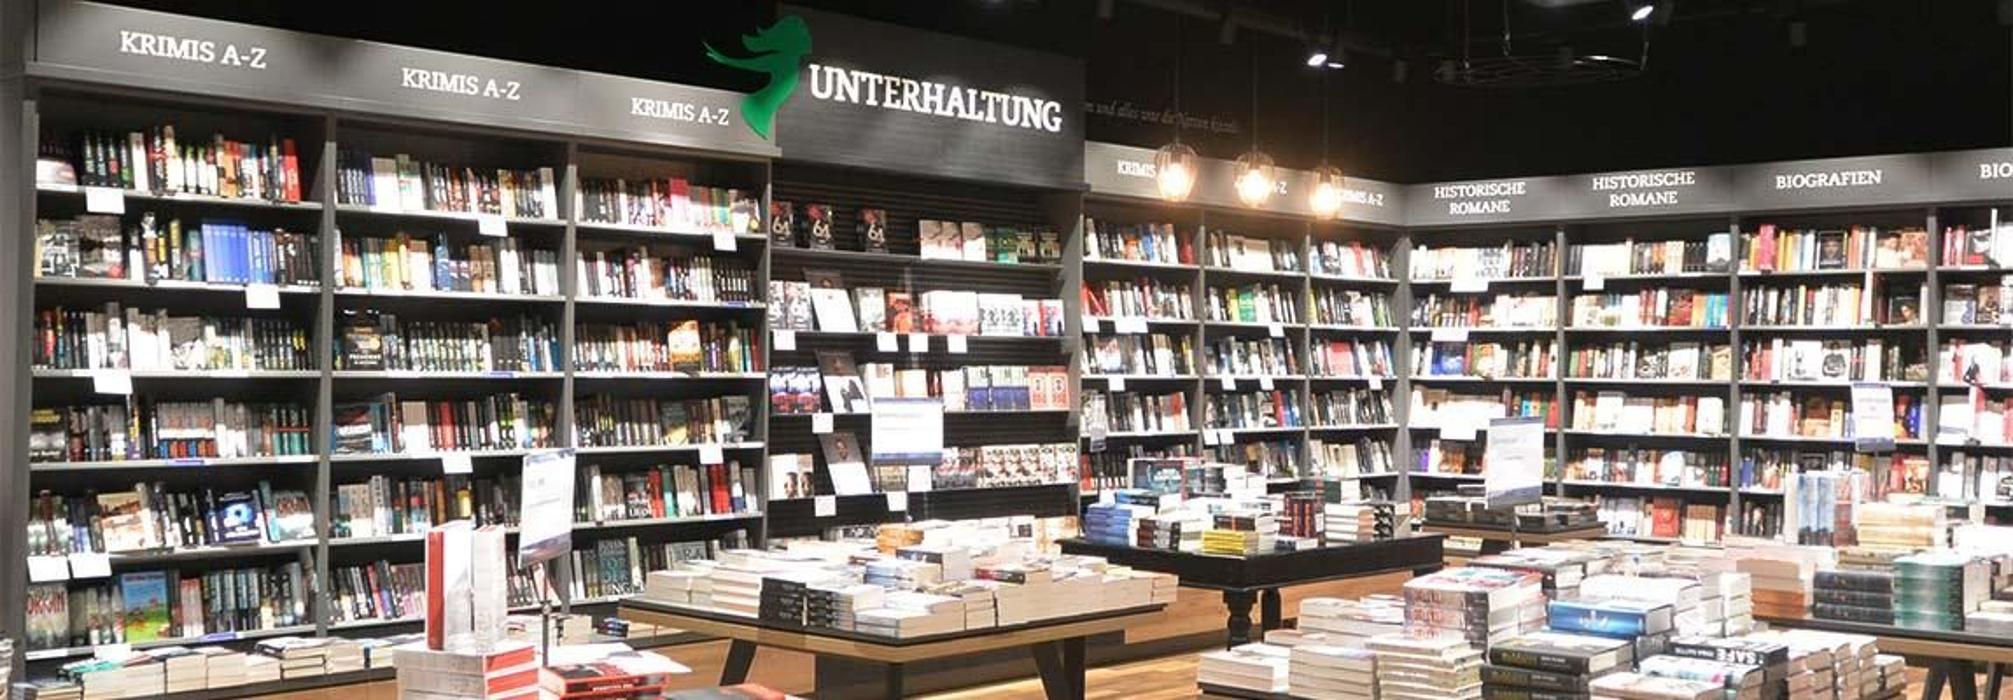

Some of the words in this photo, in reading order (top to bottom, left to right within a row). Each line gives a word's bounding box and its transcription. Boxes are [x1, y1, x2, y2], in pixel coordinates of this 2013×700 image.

[120, 31, 216, 63] KRIMIS
[220, 44, 267, 69] A-Z
[401, 67, 479, 95] KRIMIS
[483, 80, 521, 101] A-Z
[808, 64, 1063, 132] UNTERHALTUNG
[631, 98, 695, 121] KRIMIS
[698, 108, 729, 126] A-Z
[1117, 160, 1157, 178] KRIMIS
[1980, 162, 2013, 179] BIO
[1592, 172, 1696, 191] HISTORISCHE
[1776, 170, 1883, 190] BIOGRAFIEN
[1434, 182, 1527, 199] HISTORISCHE
[1609, 191, 1678, 208] ROMANE
[1449, 199, 1511, 215] ROMANE
[813, 219, 832, 239] 64
[868, 223, 885, 243] 64
[1716, 648, 1757, 665] SAFE
